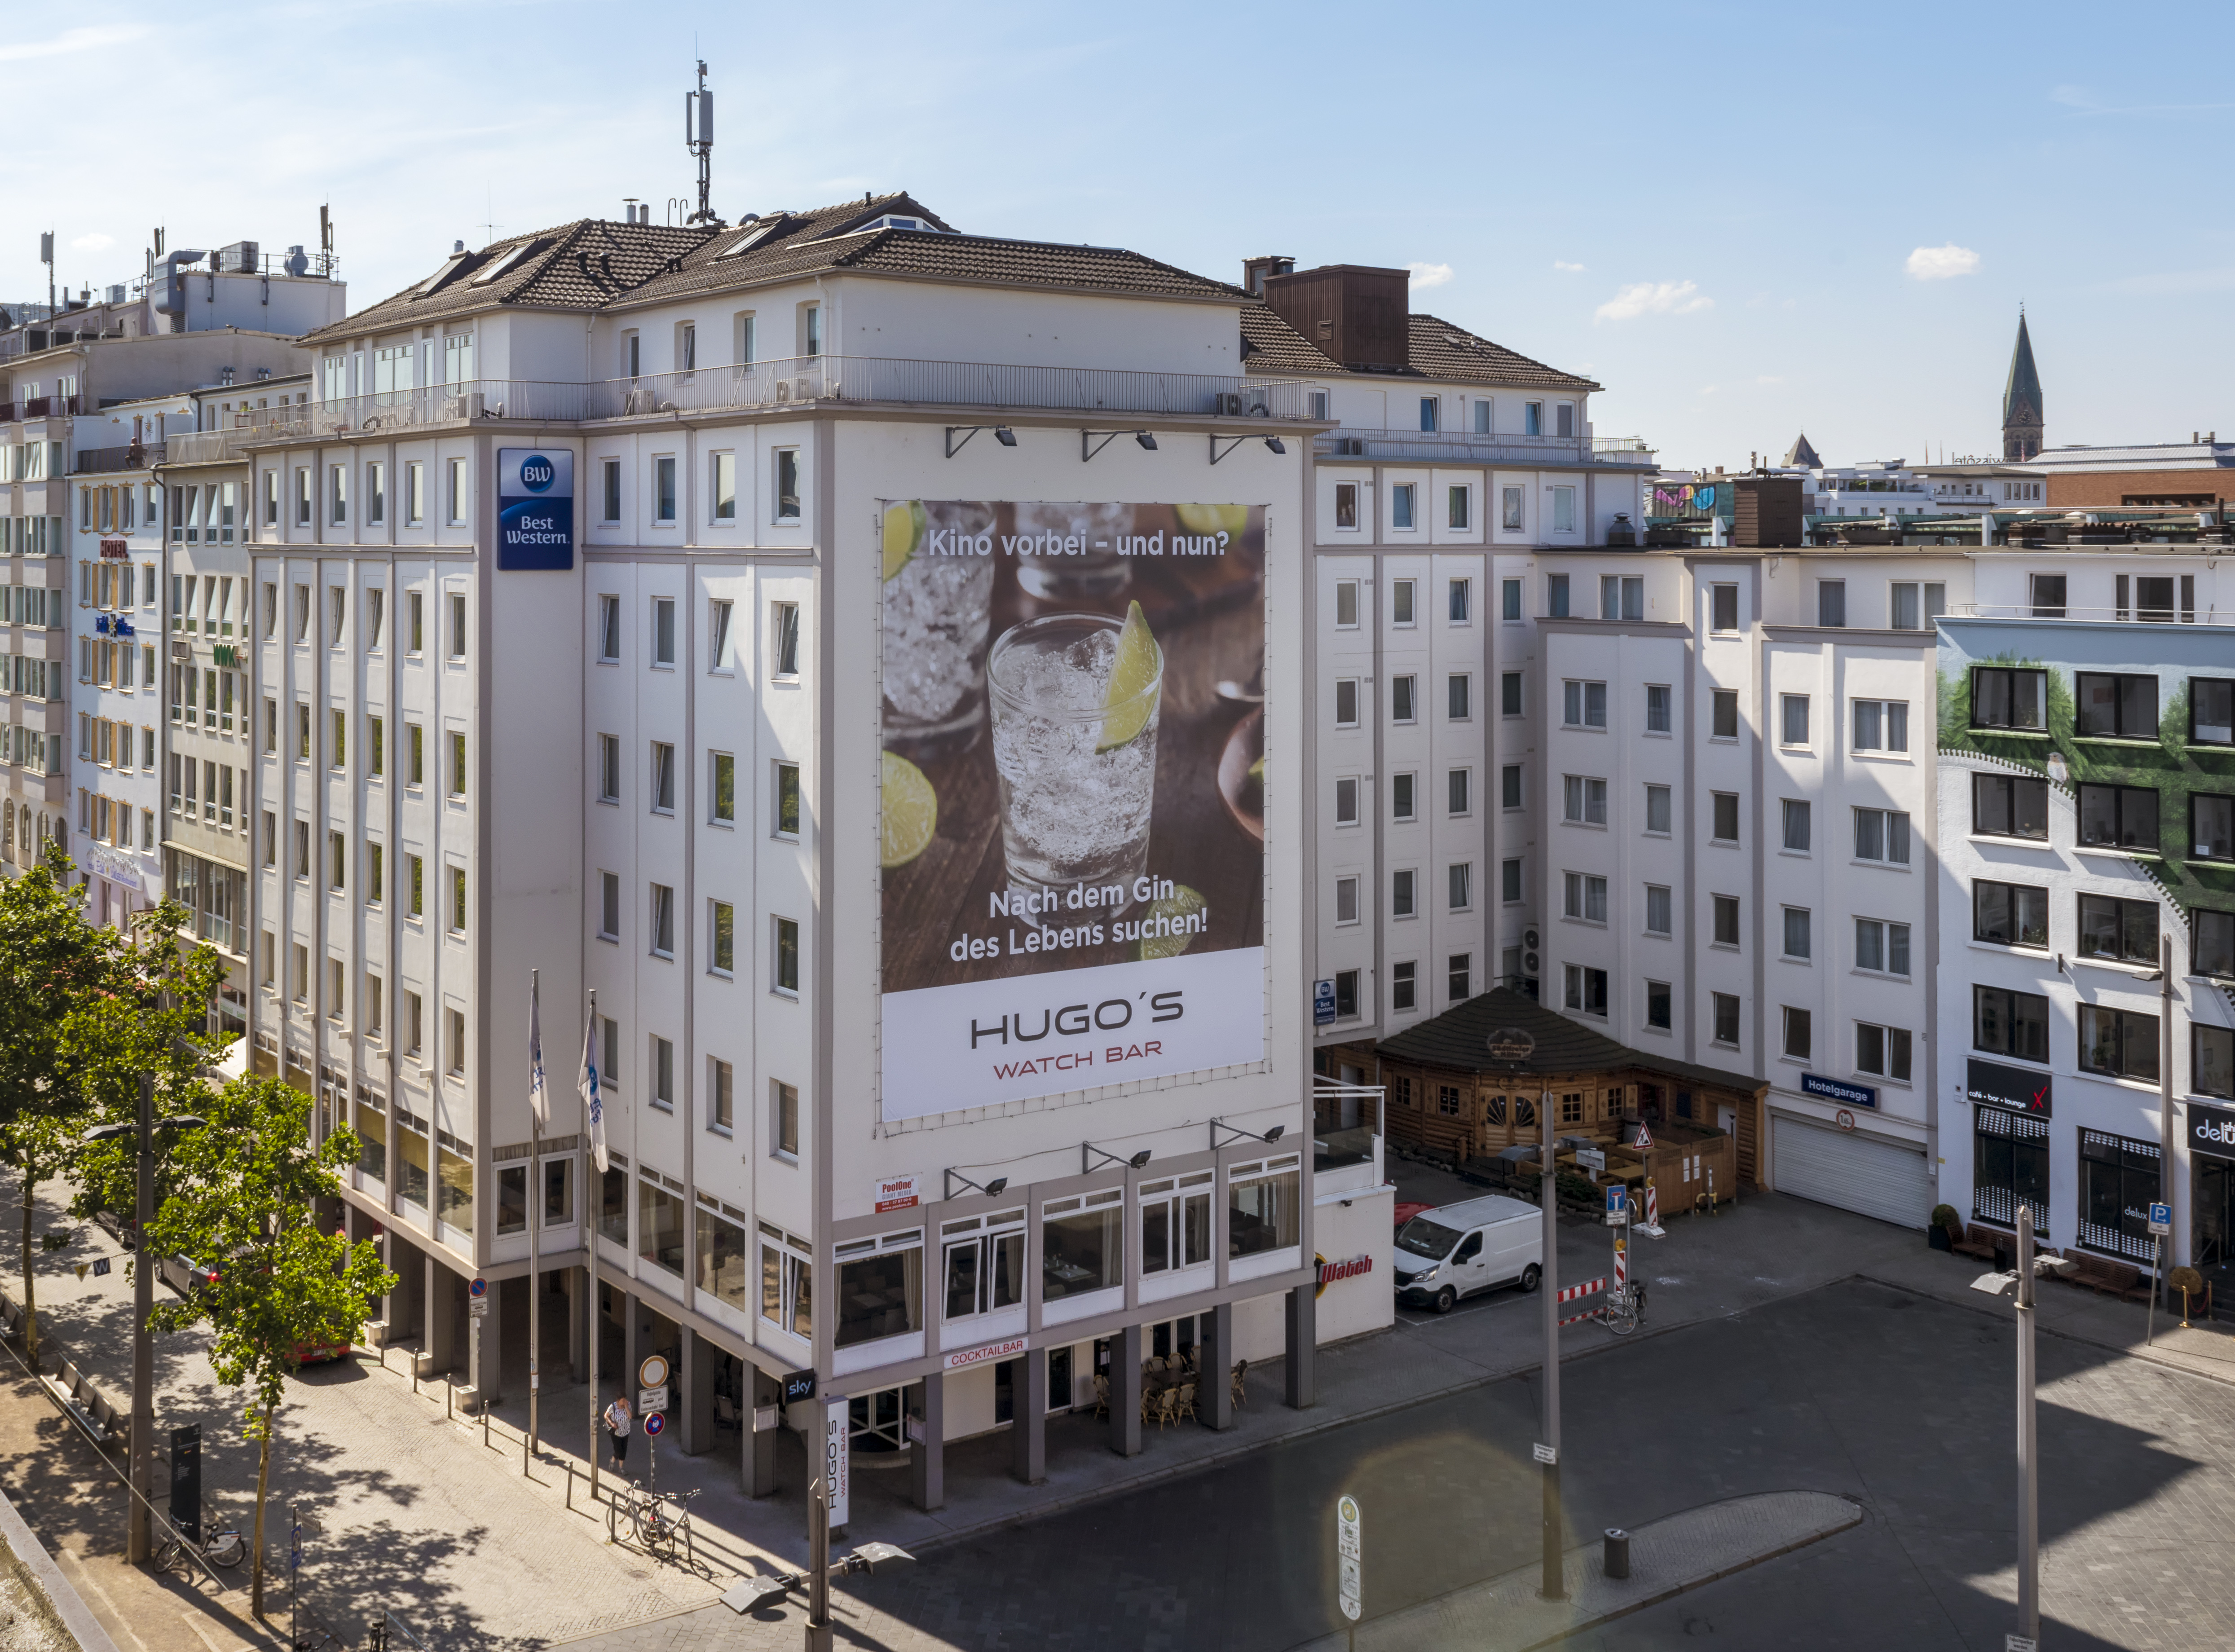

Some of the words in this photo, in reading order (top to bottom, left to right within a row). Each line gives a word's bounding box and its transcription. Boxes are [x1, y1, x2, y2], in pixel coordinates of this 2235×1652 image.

[524, 467, 551, 482] BW
[521, 516, 553, 530] Best
[507, 532, 567, 544] Western
[929, 529, 992, 556] Kino
[1001, 529, 1087, 556] vorbei
[1116, 530, 1164, 556] und
[1172, 530, 1229, 556] nun?
[100, 540, 128, 558] HOTEL
[990, 885, 1058, 918] Nach
[1067, 882, 1124, 909] dem
[1133, 874, 1174, 902] Gin
[950, 933, 1000, 962] des
[1009, 924, 1104, 955] Lebens
[1112, 907, 1208, 942] suchen!
[993, 1051, 1093, 1079] WATCH
[1106, 1040, 1163, 1063] BAR
[1808, 1079, 1868, 1101] Hotelgarage
[1968, 1091, 1982, 1099] café
[1988, 1093, 1999, 1102] bar
[2004, 1097, 2026, 1109] lounge
[882, 1181, 912, 1194] PoolOne
[882, 1192, 896, 1200] GIANT
[897, 1189, 912, 1198] MEDIA
[882, 1202, 912, 1211] www.poolone.de
[2155, 1207, 2167, 1220] P
[79, 1266, 84, 1276] 2
[94, 1259, 109, 1274] W
[1321, 1255, 1372, 1284] Watch
[952, 1340, 1023, 1366] COCKTAILBAR
[789, 1379, 812, 1395] sky
